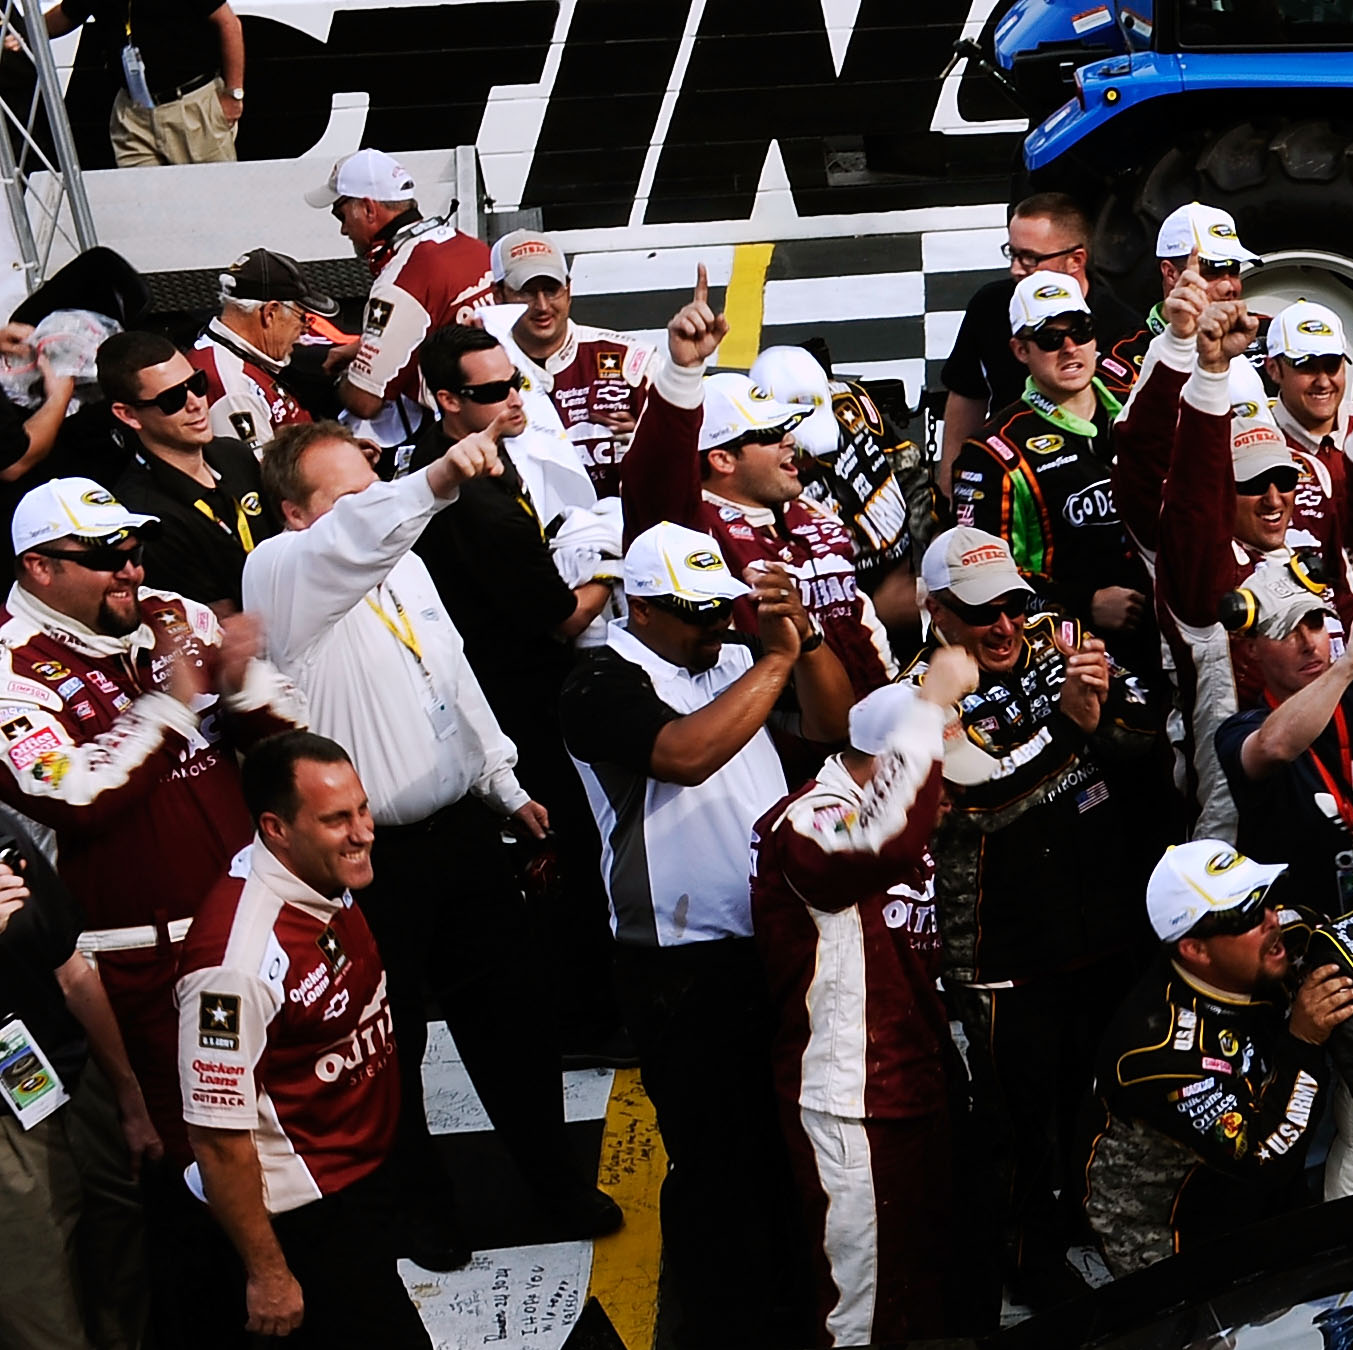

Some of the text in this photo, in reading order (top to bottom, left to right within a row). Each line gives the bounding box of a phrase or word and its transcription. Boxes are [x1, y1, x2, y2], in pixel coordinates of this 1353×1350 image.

[289, 962, 328, 1003] Quicken
[192, 1059, 245, 1075] Quicken
[200, 1073, 239, 1087] Loans
[192, 1093, 245, 1107] OUTBACK
